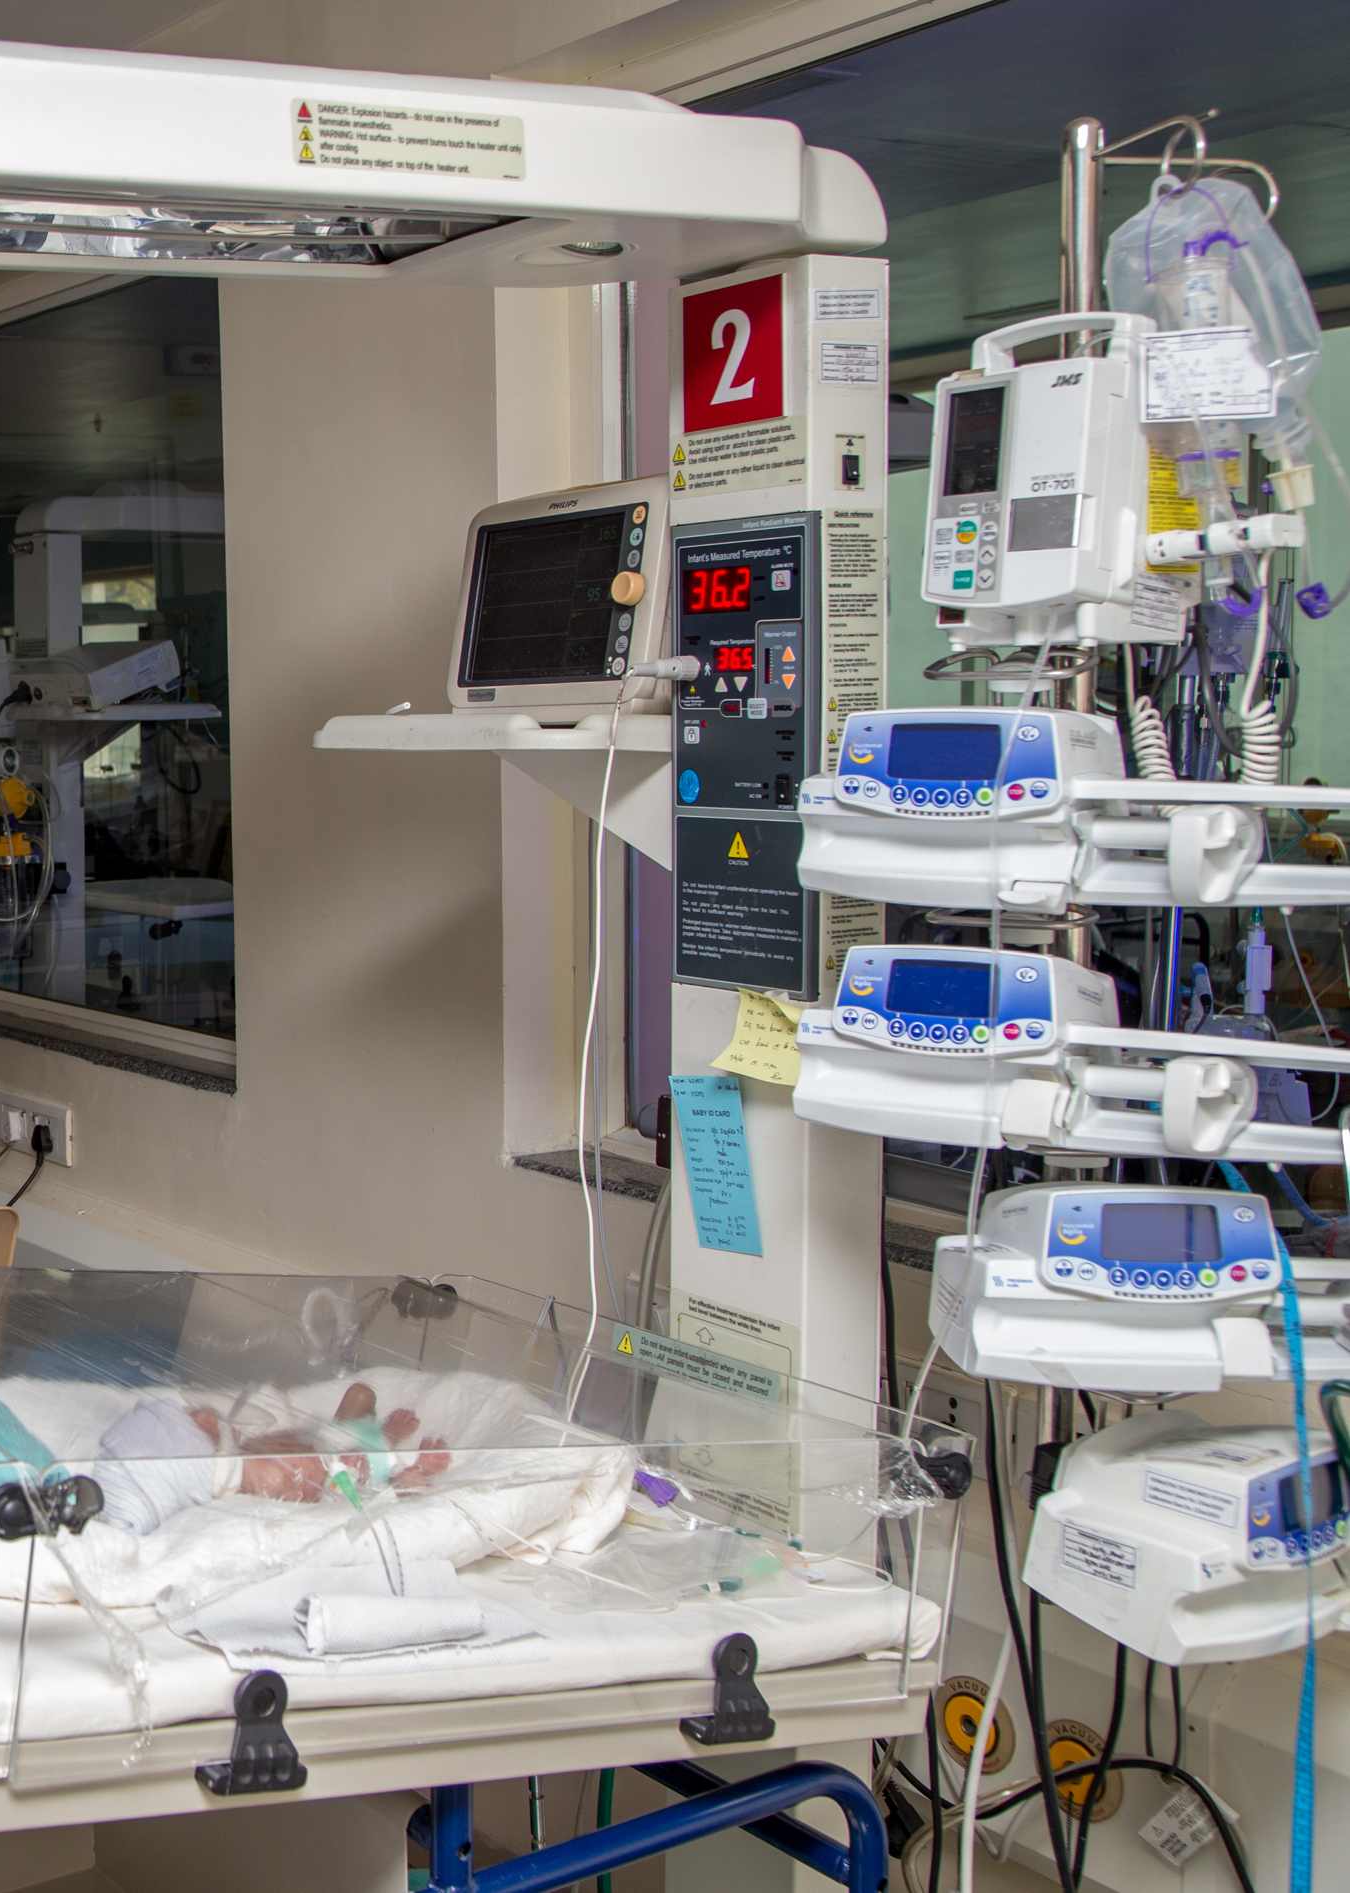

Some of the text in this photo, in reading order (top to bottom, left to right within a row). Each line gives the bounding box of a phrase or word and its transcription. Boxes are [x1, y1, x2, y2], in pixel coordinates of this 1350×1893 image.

[318, 104, 350, 114] DANGER:
[352, 107, 382, 117] Explosion
[384, 110, 408, 119] hazards
[454, 116, 463, 124] the
[319, 116, 350, 126] flammable
[353, 121, 393, 130] anaesthetics.
[320, 130, 354, 139] WARNING:
[370, 134, 391, 142] surface
[430, 139, 447, 147] burns
[449, 140, 464, 148] touch
[467, 141, 475, 149] the
[477, 142, 496, 150] heater
[510, 145, 522, 154] only
[320, 142, 358, 154] after cooling
[321, 155, 330, 163] Do
[343, 157, 359, 165] place
[362, 159, 373, 168] any
[375, 159, 393, 169] object
[406, 162, 415, 170] top
[437, 164, 456, 172] heater
[710, 308, 756, 406] 2
[1050, 372, 1083, 388] JMS
[722, 433, 740, 441] solvents
[747, 428, 769, 437] flammable
[771, 425, 792, 433] solutions.
[768, 435, 782, 444] plastic
[752, 448, 765, 456] plastic
[767, 446, 779, 454] parts.
[1031, 479, 1075, 492] OT-701
[548, 499, 579, 510] PHILIPS
[760, 519, 782, 527] Radiant
[783, 516, 808, 524] Warmer
[598, 525, 617, 541] 165
[688, 552, 710, 563] Infant's
[710, 550, 740, 562] Measured
[742, 547, 780, 560] Temperature
[587, 587, 601, 602] 95
[690, 567, 750, 610] 36.2
[697, 1300, 716, 1311] effective
[716, 1306, 737, 1317] treatment
[739, 1313, 758, 1324] maintain
[767, 1322, 780, 1332] infant
[698, 1308, 708, 1316] level
[709, 1312, 728, 1322] between
[737, 1321, 749, 1329] white
[750, 1324, 762, 1333] lines.
[641, 1337, 772, 1386] Do not leave infant unattended when any panel is
[639, 1348, 768, 1396] open. All panels must be closed and secured
[950, 1680, 988, 1697] VACUU
